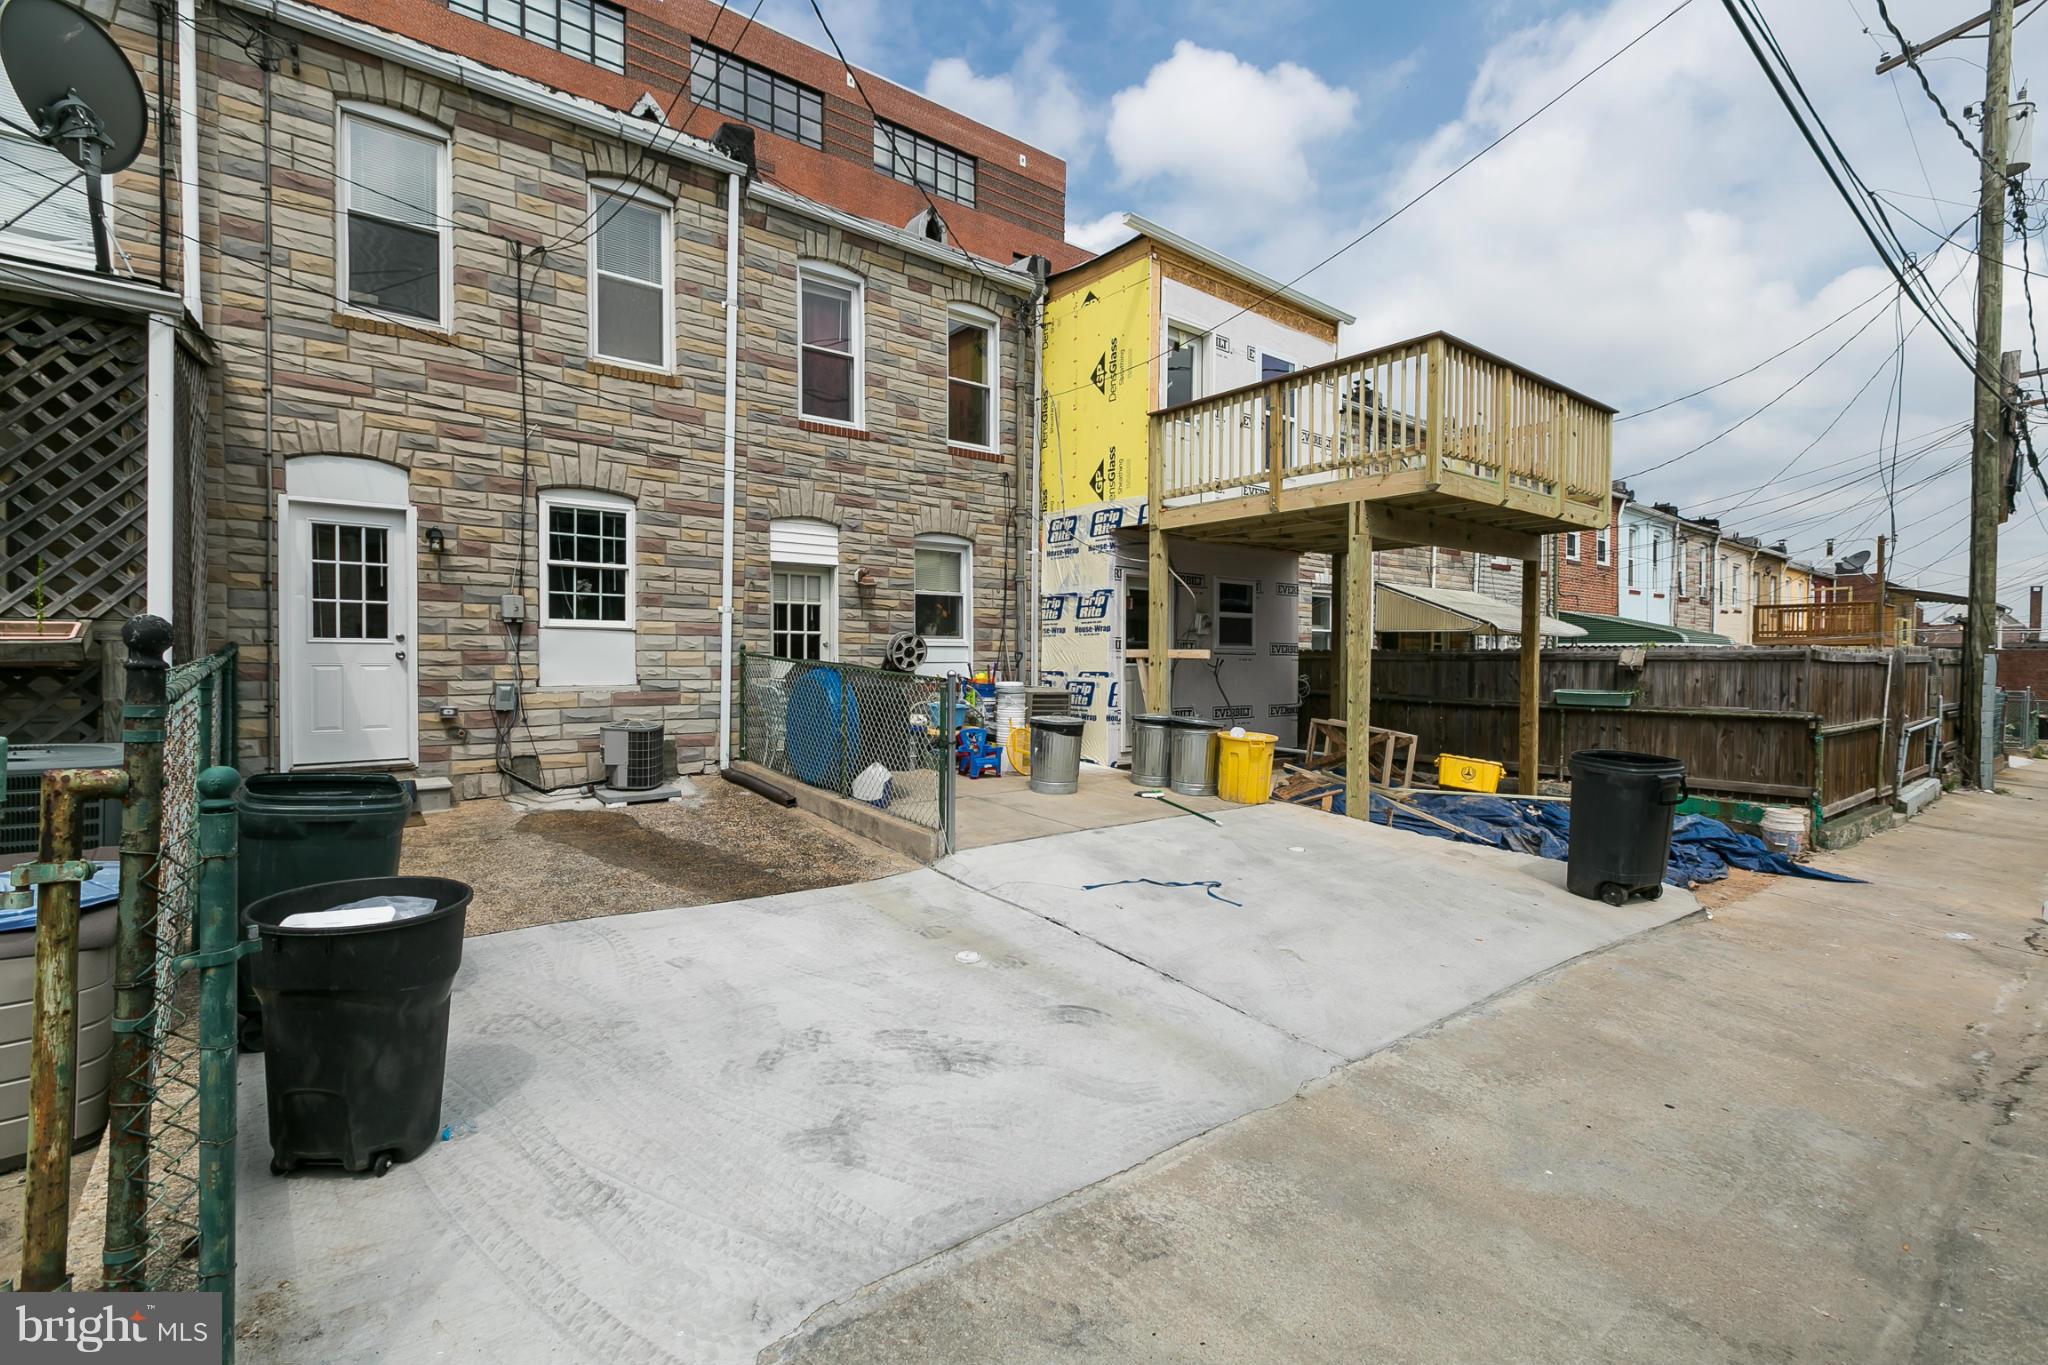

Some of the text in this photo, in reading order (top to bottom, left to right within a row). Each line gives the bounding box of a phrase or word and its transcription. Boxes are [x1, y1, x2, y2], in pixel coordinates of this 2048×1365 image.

[1108, 337, 1118, 403] DensGlass
[1095, 511, 1120, 524] Grip
[1052, 518, 1074, 532] Grip
[1080, 595, 1105, 607] Grip
[1079, 606, 1102, 618] Rite
[1075, 624, 1111, 633] House-Wrap
[1214, 707, 1250, 718] EVERBILT
